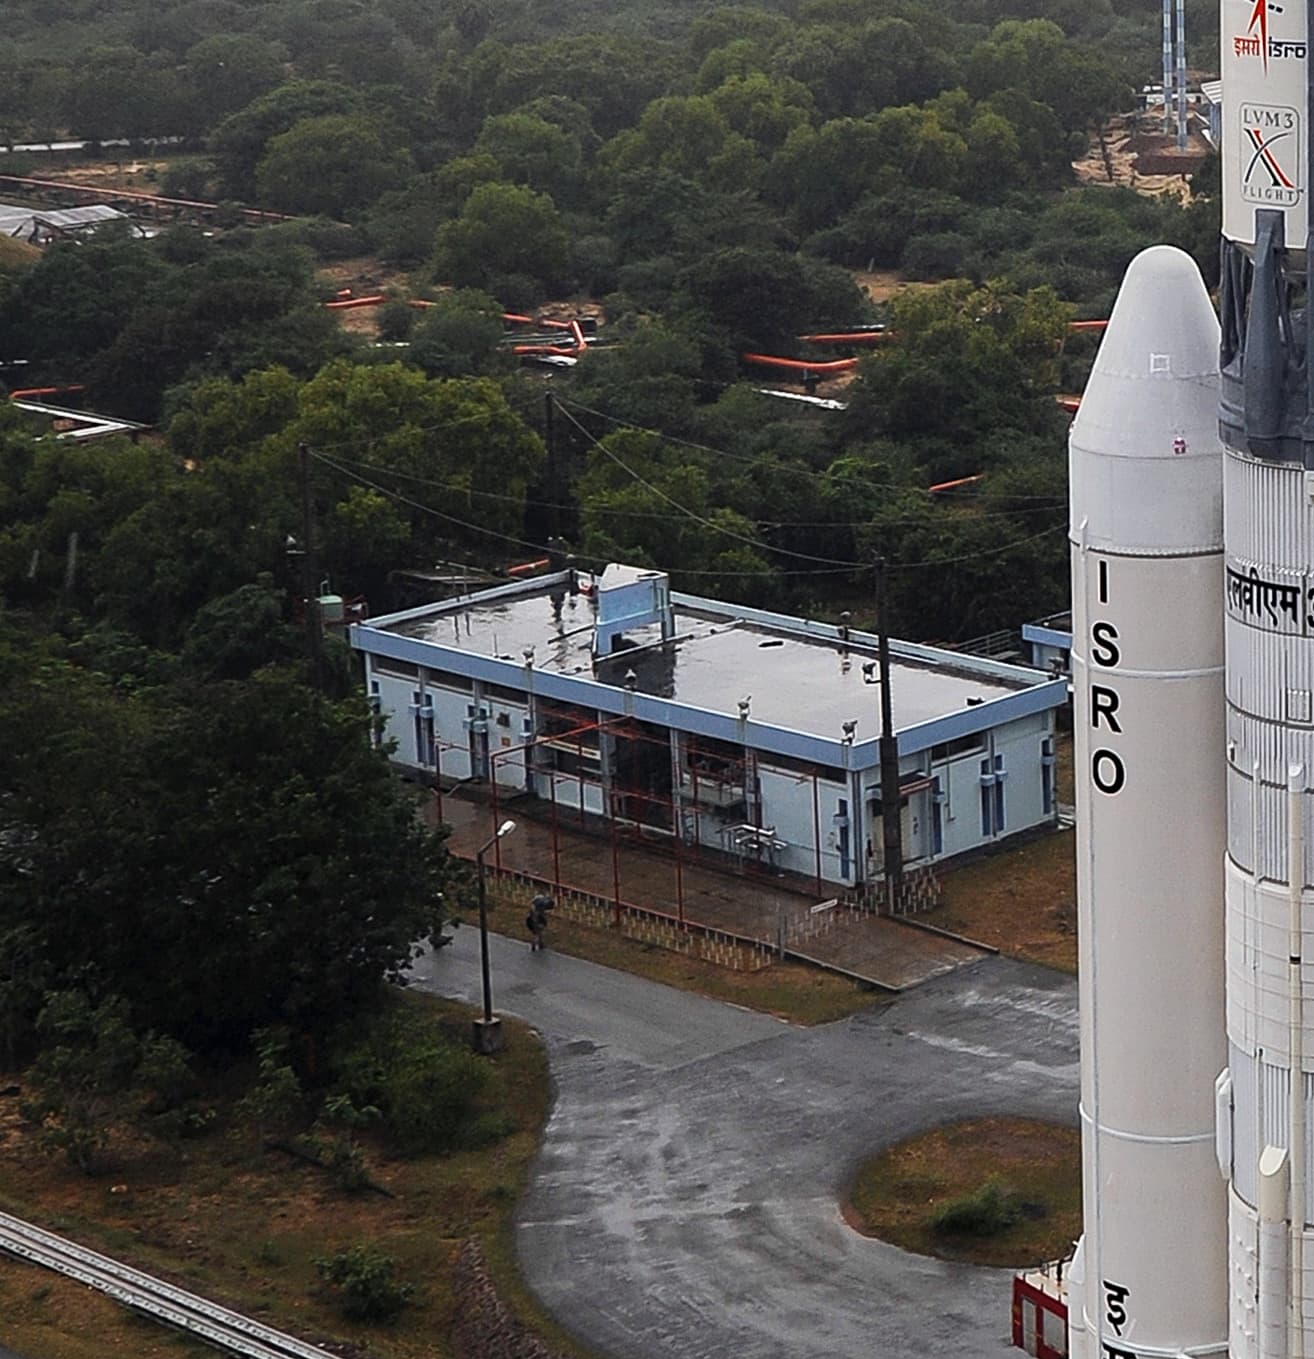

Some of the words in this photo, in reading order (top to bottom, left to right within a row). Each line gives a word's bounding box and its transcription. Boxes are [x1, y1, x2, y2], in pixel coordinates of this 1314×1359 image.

[1233, 33, 1260, 57] इसरो
[1268, 36, 1307, 59] isro
[1243, 185, 1294, 202] FLIGHT
[1092, 561, 1125, 795] ISRO
